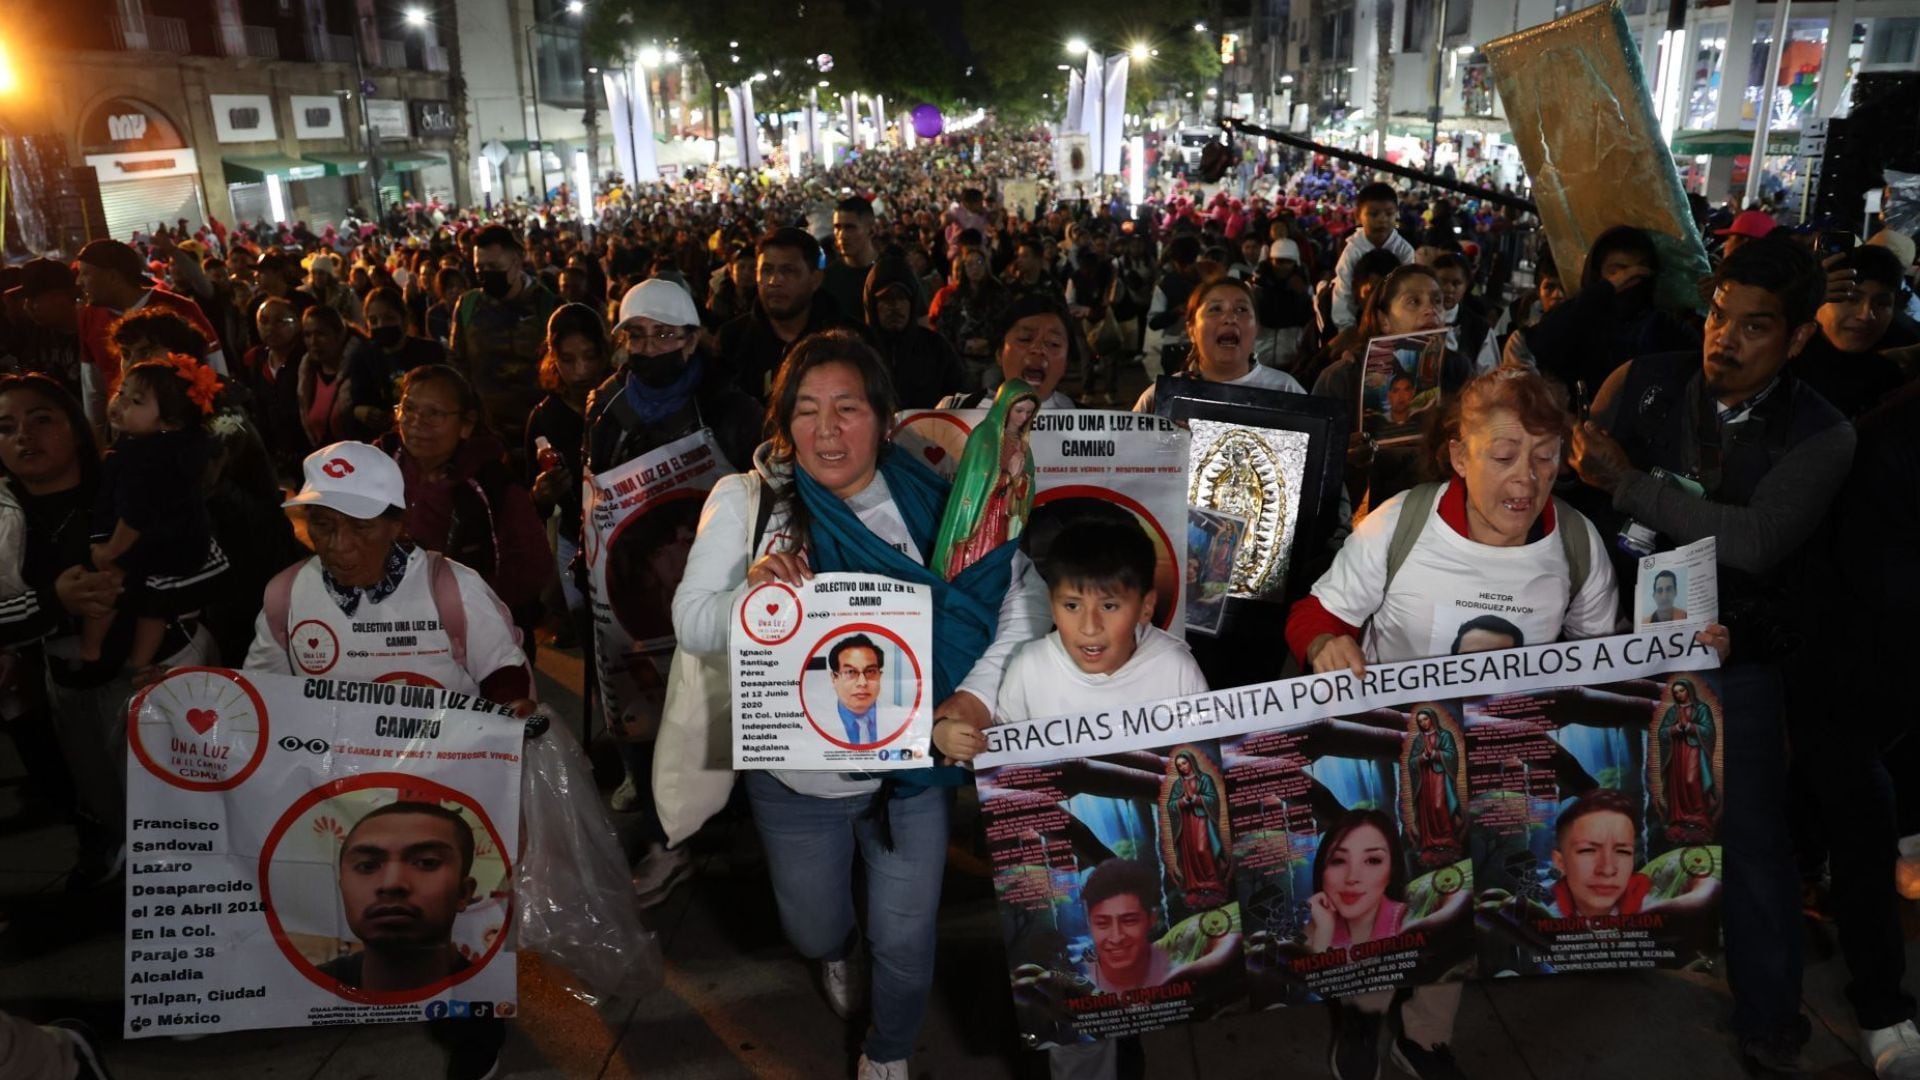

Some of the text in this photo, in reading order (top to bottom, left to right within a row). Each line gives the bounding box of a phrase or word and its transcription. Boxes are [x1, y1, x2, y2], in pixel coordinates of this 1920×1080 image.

[1030, 415, 1174, 431] ECTIVO UNA LUZ EN EL
[1062, 440, 1115, 457] CAMINO
[636, 468, 657, 487] LUZ
[656, 461, 672, 477] EN
[814, 581, 916, 594] COLECTIVO UNA LUZ EN EL
[849, 596, 882, 607] CAMINO
[1479, 592, 1514, 602] HECTOR
[1455, 599, 1534, 614] RODRIGUEZ PAVON
[352, 622, 393, 633] COLECTIVO
[394, 621, 410, 632] UNA
[412, 621, 426, 631] LUZ
[427, 620, 437, 630] EN
[386, 636, 417, 647] CAMINO
[740, 649, 773, 657] Ignacio
[740, 680, 801, 688] Desaparecido
[303, 678, 396, 706] COLECTIVO
[400, 686, 434, 709] UNA
[439, 689, 470, 710] LUZ
[471, 697, 496, 713] EN
[986, 630, 1709, 753] GRACIAS MORENITA POR REGRESARLOS A CASA
[741, 701, 763, 709] 2020
[774, 711, 805, 719] Unidad
[375, 715, 441, 739] CAMINO
[171, 737, 230, 760] UNA LUZ
[347, 746, 380, 757] CANSAS
[382, 749, 393, 758] DE
[742, 744, 789, 753] Magdalena
[196, 758, 228, 772] CAMINO
[179, 768, 219, 781] CDMX
[132, 818, 219, 831] Francisco
[132, 839, 213, 853] Sandoval
[132, 862, 192, 875] Lazaro
[132, 880, 253, 897] Desaparecido
[131, 901, 268, 918] el 26 Abril 2018
[131, 924, 216, 940] En la Col.
[131, 946, 216, 963] Paraje 38
[130, 985, 266, 1006] Tlalpan, Ciudad
[130, 1012, 221, 1028] de México
